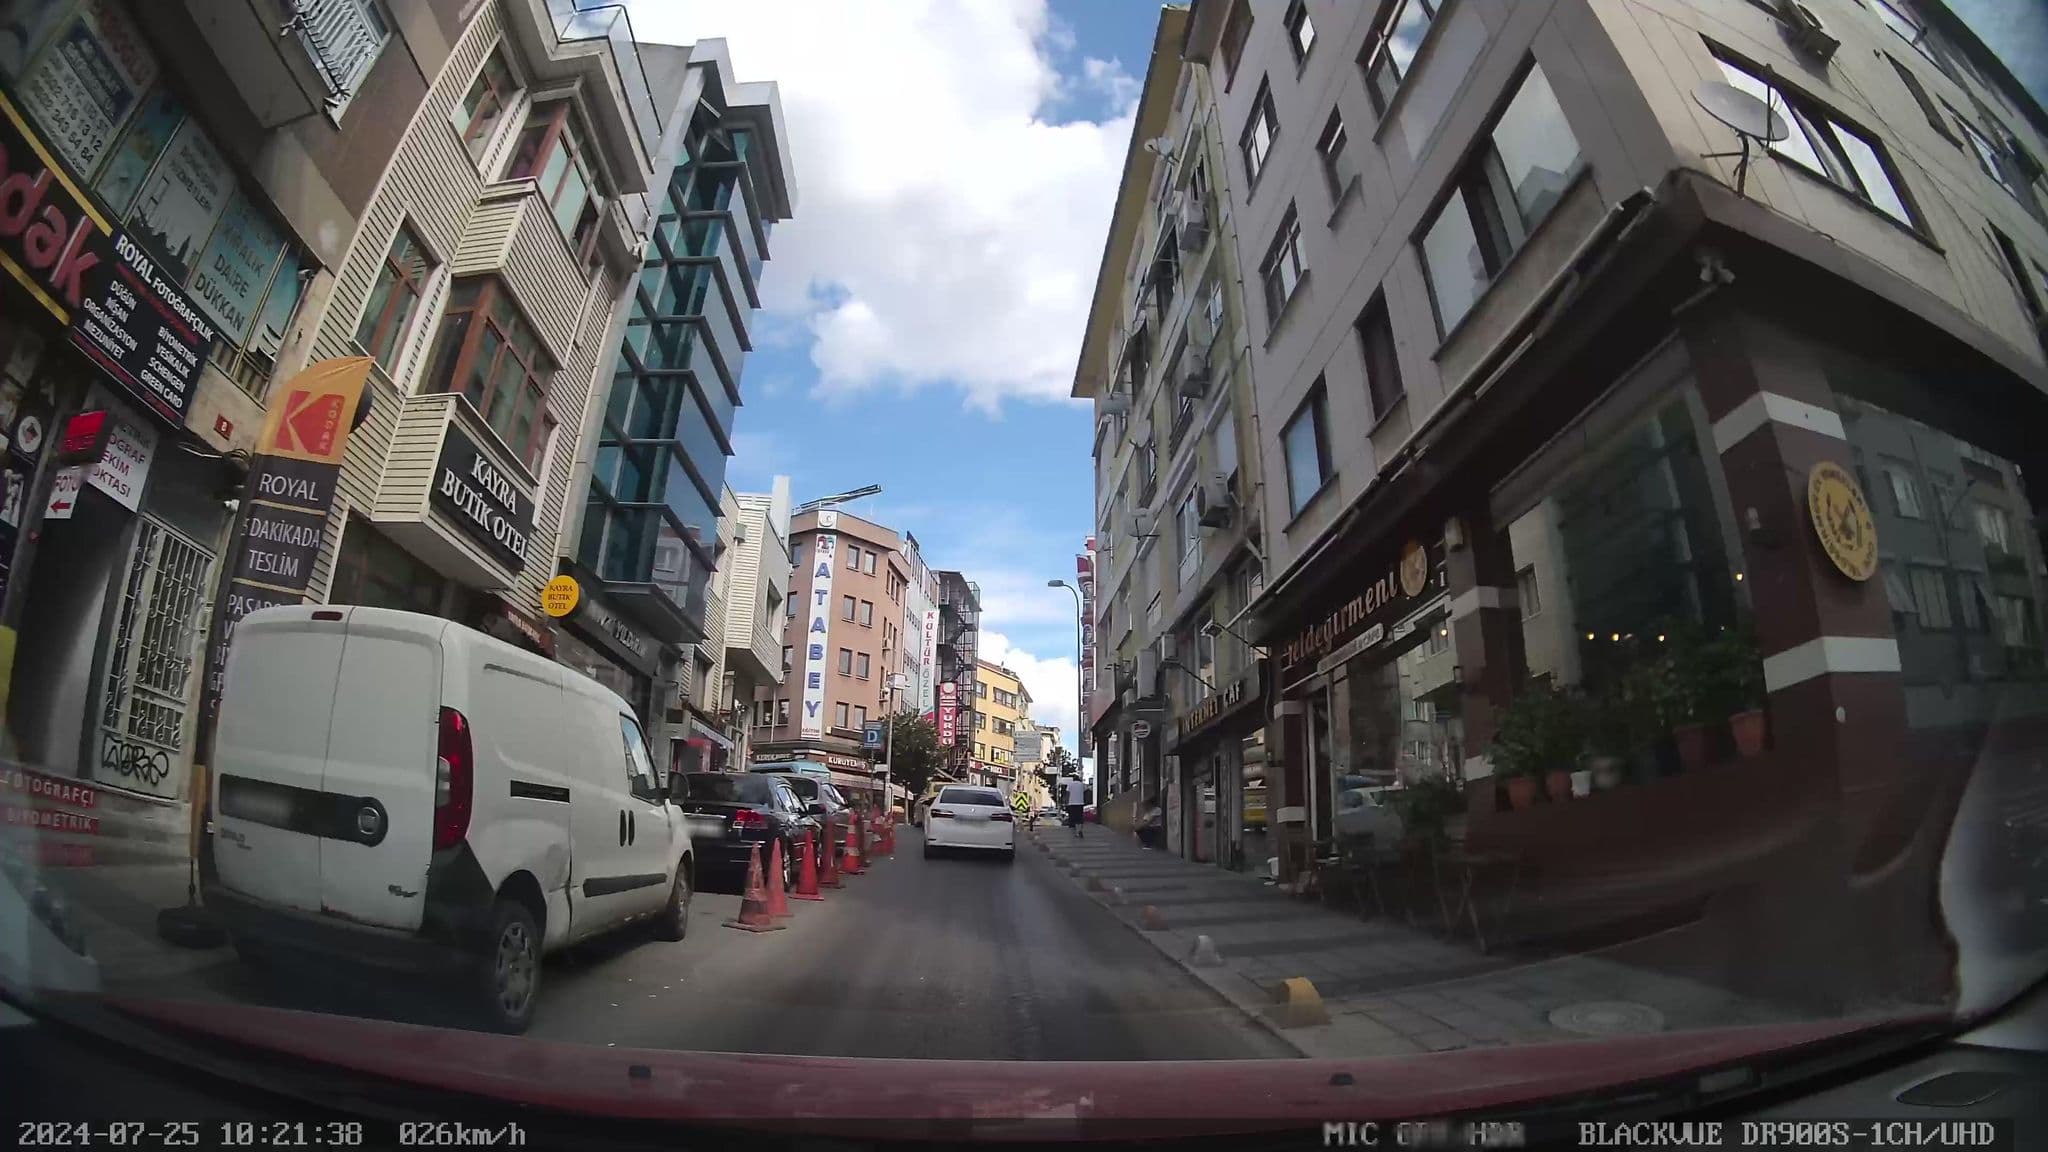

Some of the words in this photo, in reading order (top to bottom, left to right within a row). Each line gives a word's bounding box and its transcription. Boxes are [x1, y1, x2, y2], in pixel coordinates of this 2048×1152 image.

[0, 143, 100, 308] dak
[110, 280, 137, 311] DÜĞÜN
[115, 234, 153, 284] ROYAL
[153, 277, 215, 342] FOTOĞRAFÇILIK
[213, 253, 250, 299] DAİRE
[194, 273, 245, 333] DÜKKAN
[84, 298, 138, 351] ORGANİZASYON
[84, 319, 125, 359] MEZUNİYET
[156, 343, 190, 379] VESİKALIK
[158, 326, 198, 368] BİYOMETRİK
[141, 369, 165, 394] GREEN
[163, 388, 183, 408] CARD
[148, 357, 186, 393] SCHENGEN
[93, 466, 131, 498] OKTASI
[102, 451, 130, 476] EKİM
[259, 473, 319, 501] ROYAL
[471, 453, 517, 515] KAYRA
[249, 518, 320, 548] DAKİKADA
[441, 468, 491, 532] BUTİK
[492, 511, 529, 560] OTEL
[249, 549, 299, 578] TESLİM
[805, 562, 831, 718] ATABEY
[867, 730, 878, 742] D
